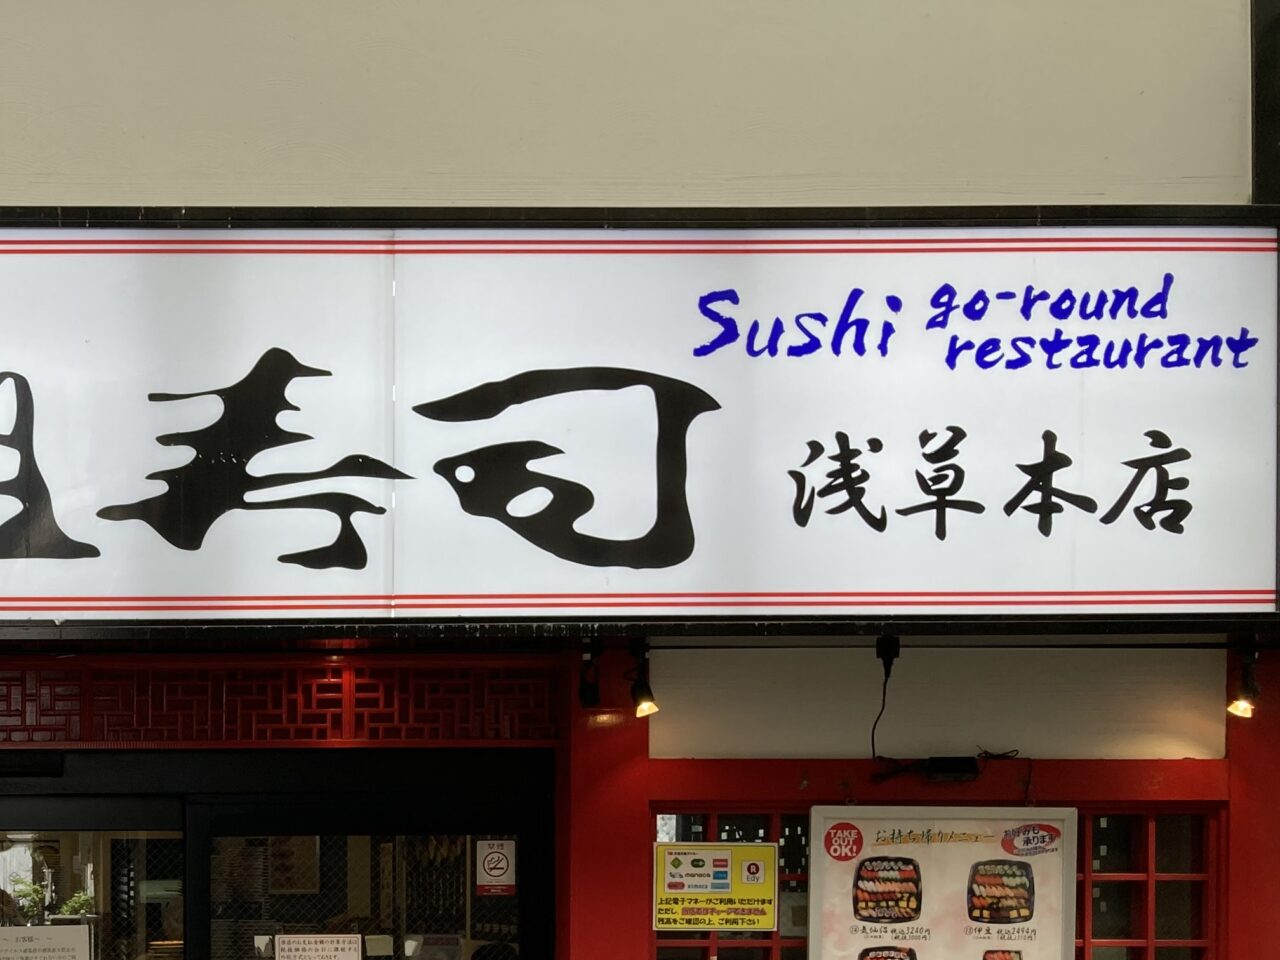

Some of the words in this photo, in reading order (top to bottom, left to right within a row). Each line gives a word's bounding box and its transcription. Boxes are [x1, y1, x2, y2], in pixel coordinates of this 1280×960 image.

[692, 288, 902, 358] Sushi
[926, 273, 1173, 330] go-round
[945, 327, 1259, 370] restaurant
[787, 426, 1192, 540] 浅草本店
[829, 830, 858, 838] TAKE
[832, 838, 854, 846] OUT
[829, 845, 857, 857] OK!
